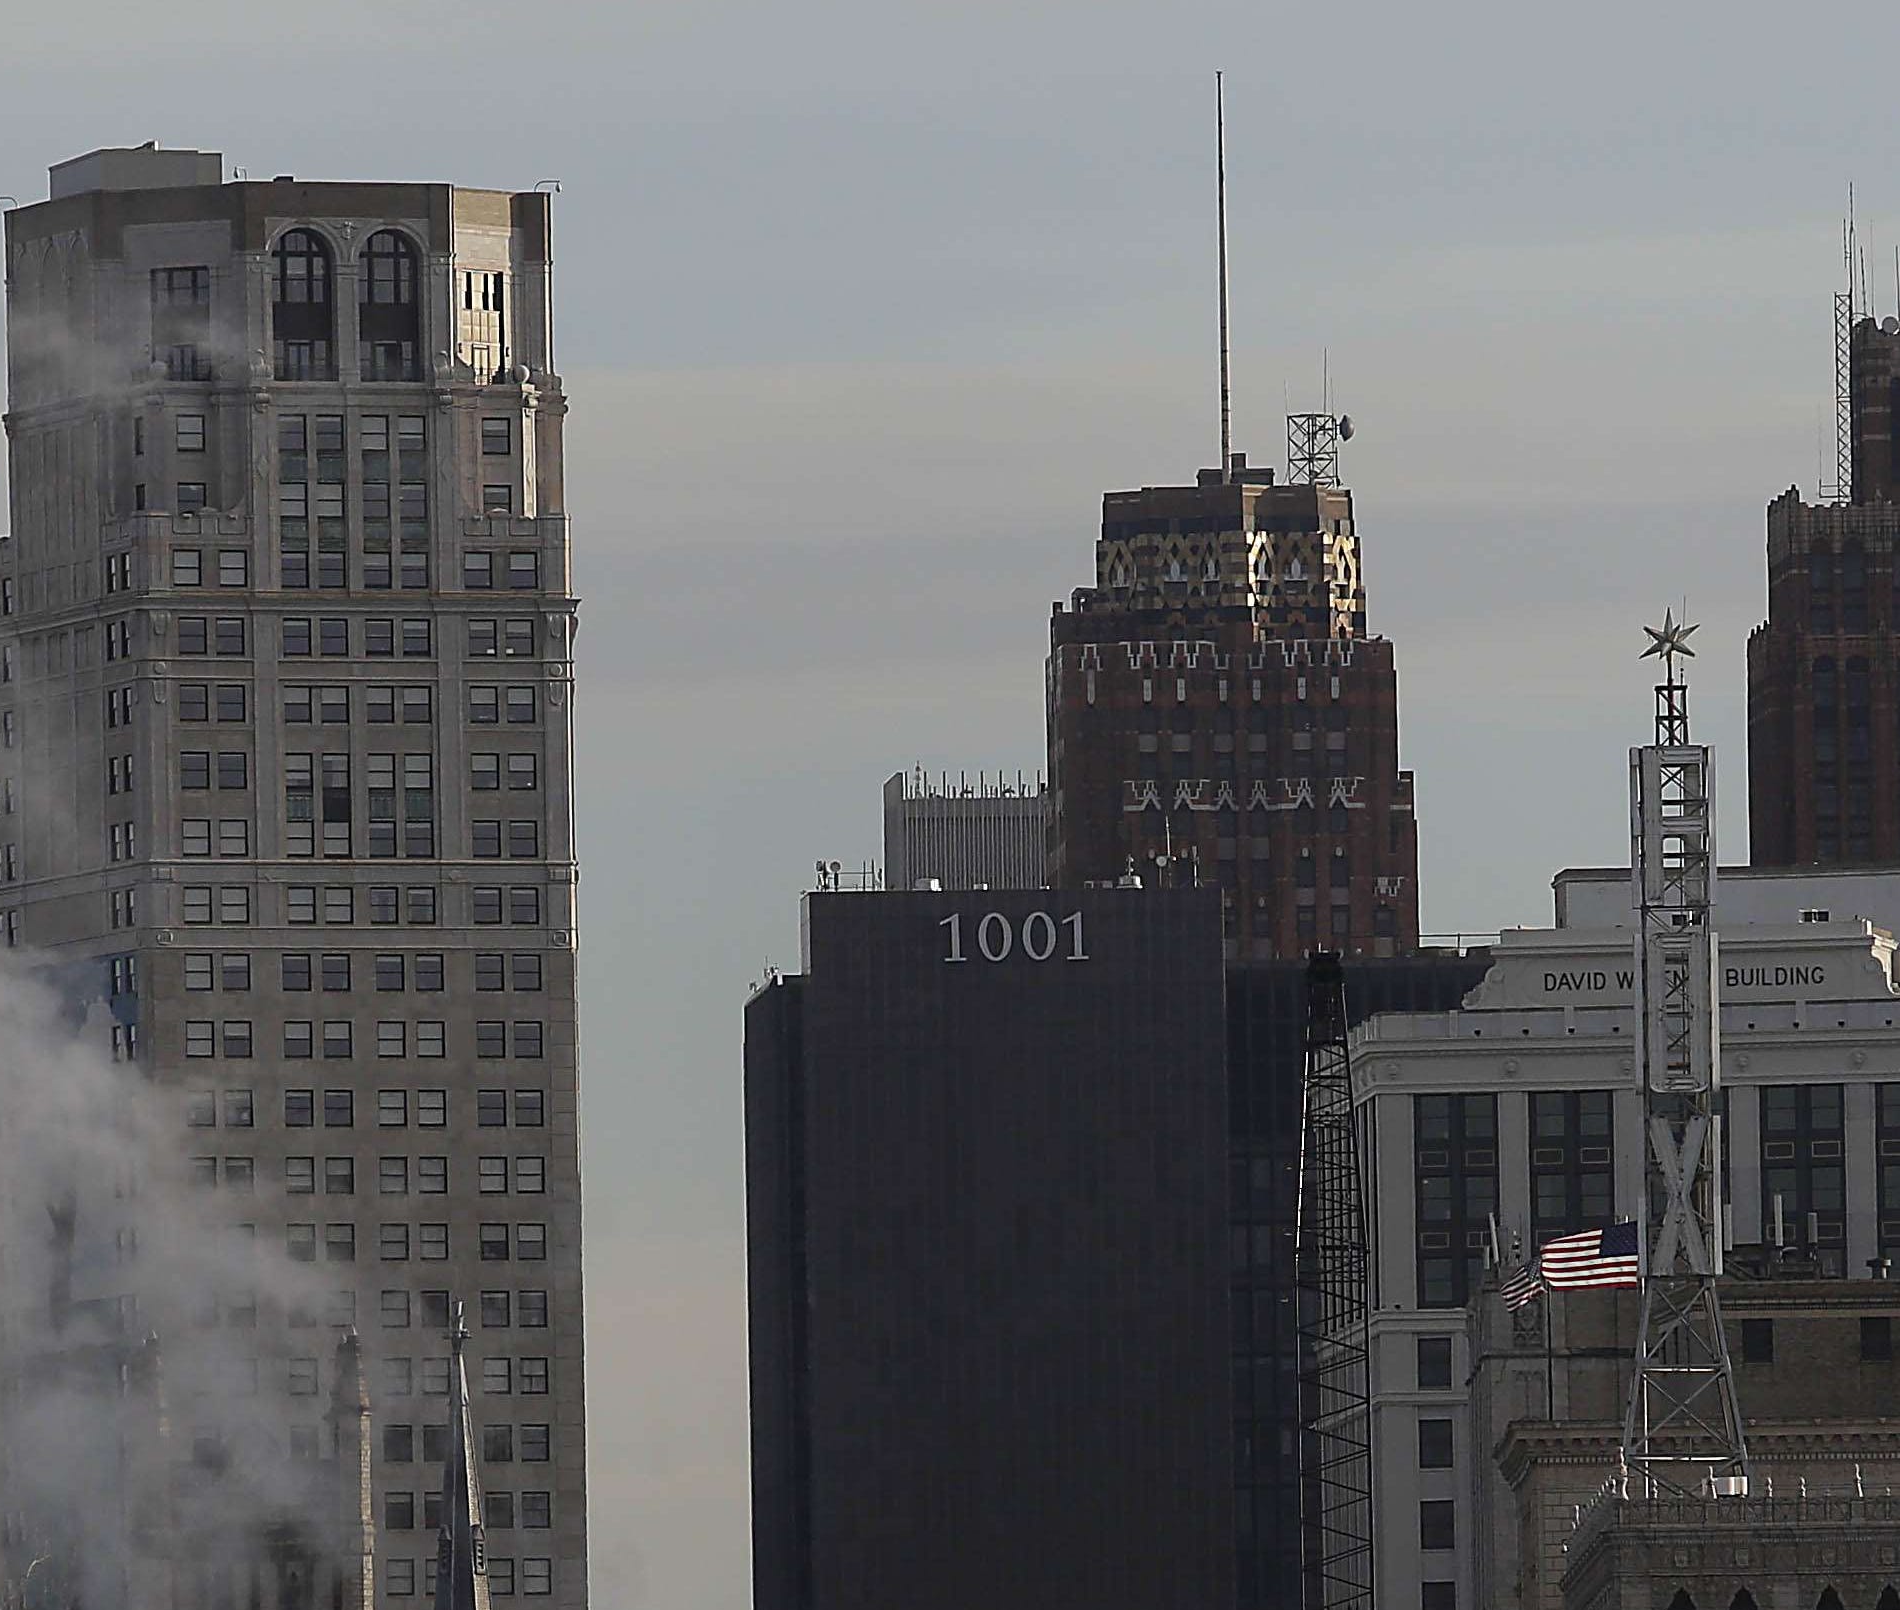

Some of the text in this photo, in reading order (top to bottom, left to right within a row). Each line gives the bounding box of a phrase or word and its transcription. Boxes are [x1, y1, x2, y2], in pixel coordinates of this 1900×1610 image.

[939, 910, 1090, 963] 1001
[1544, 972, 1607, 991] DAVID
[1725, 966, 1825, 986] BUILDING
